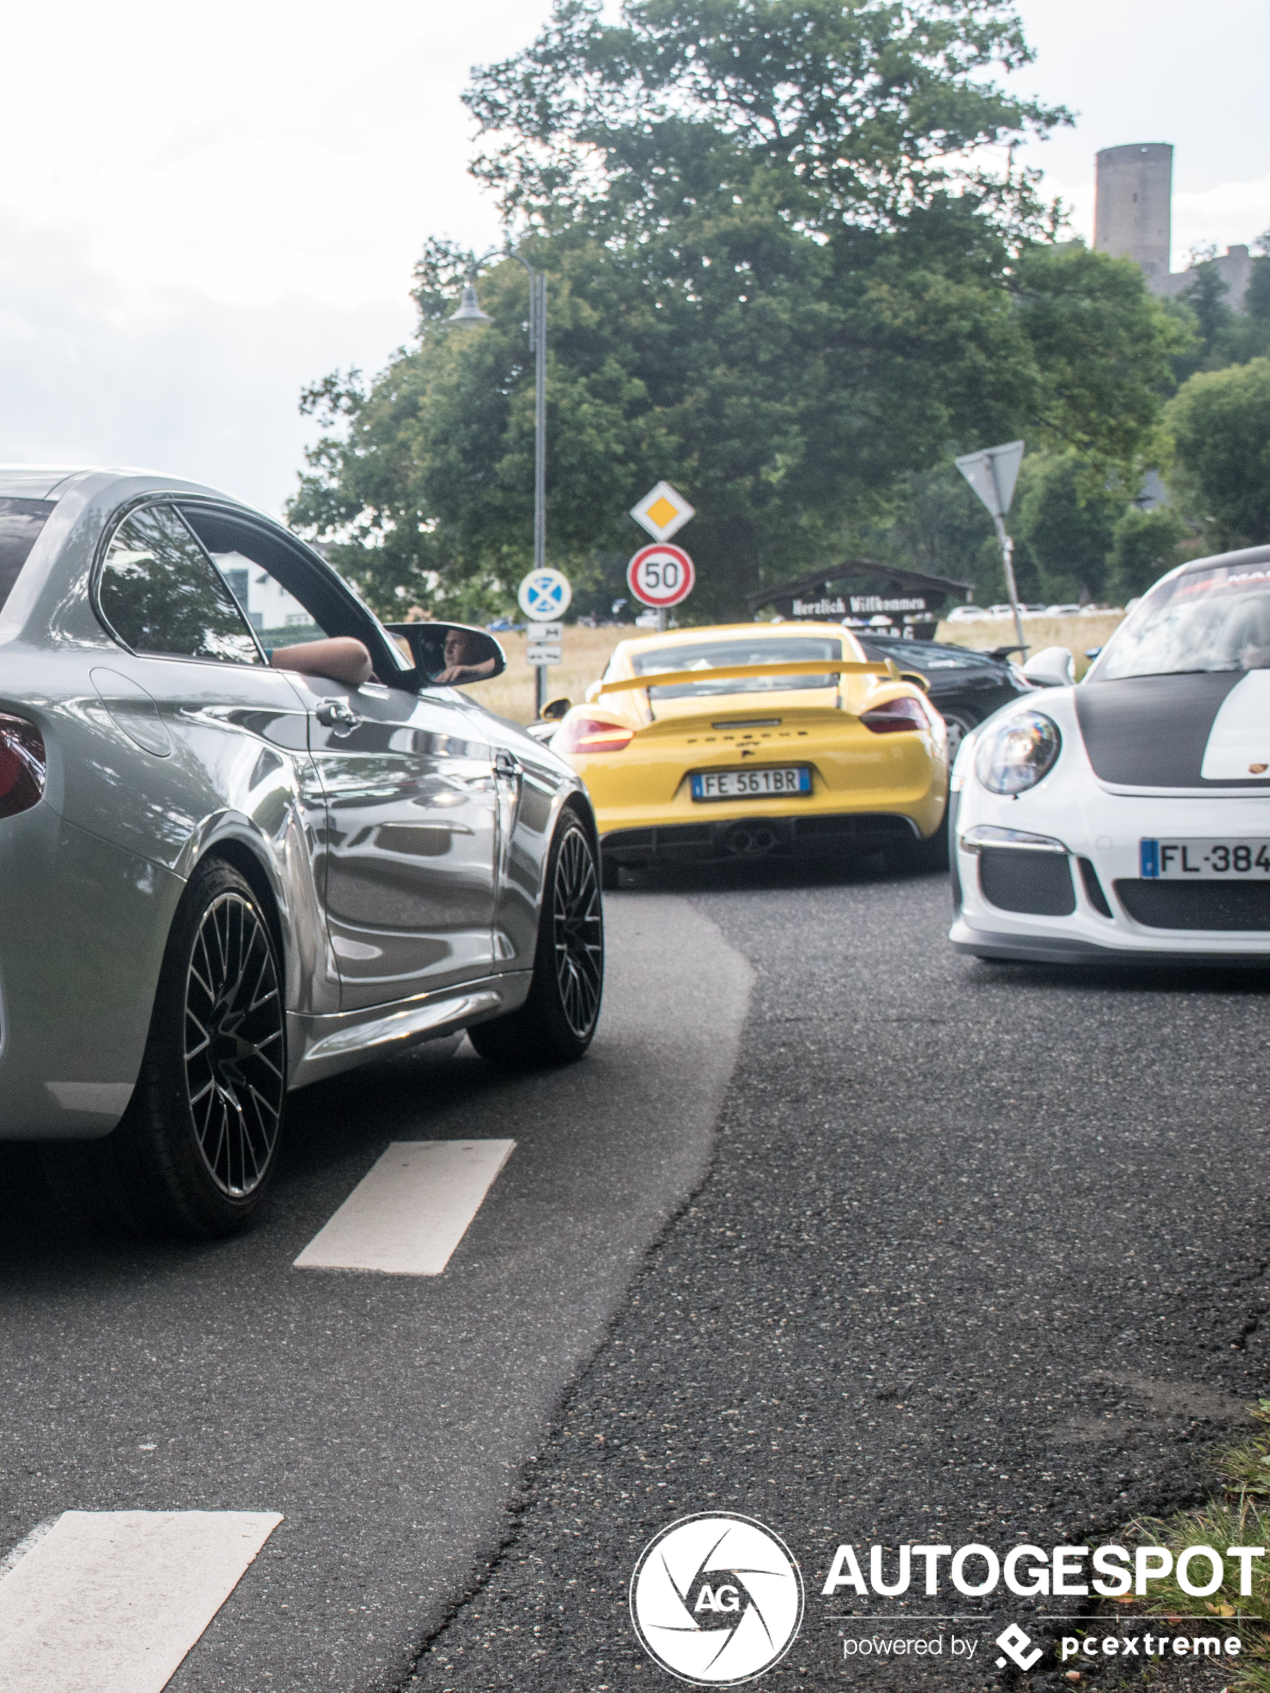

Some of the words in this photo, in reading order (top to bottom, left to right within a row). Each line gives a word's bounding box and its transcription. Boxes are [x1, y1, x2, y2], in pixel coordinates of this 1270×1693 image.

[644, 562, 679, 588] 50
[792, 597, 846, 616] Herzlich
[850, 595, 925, 612] Willkommen
[705, 775, 728, 794] FE
